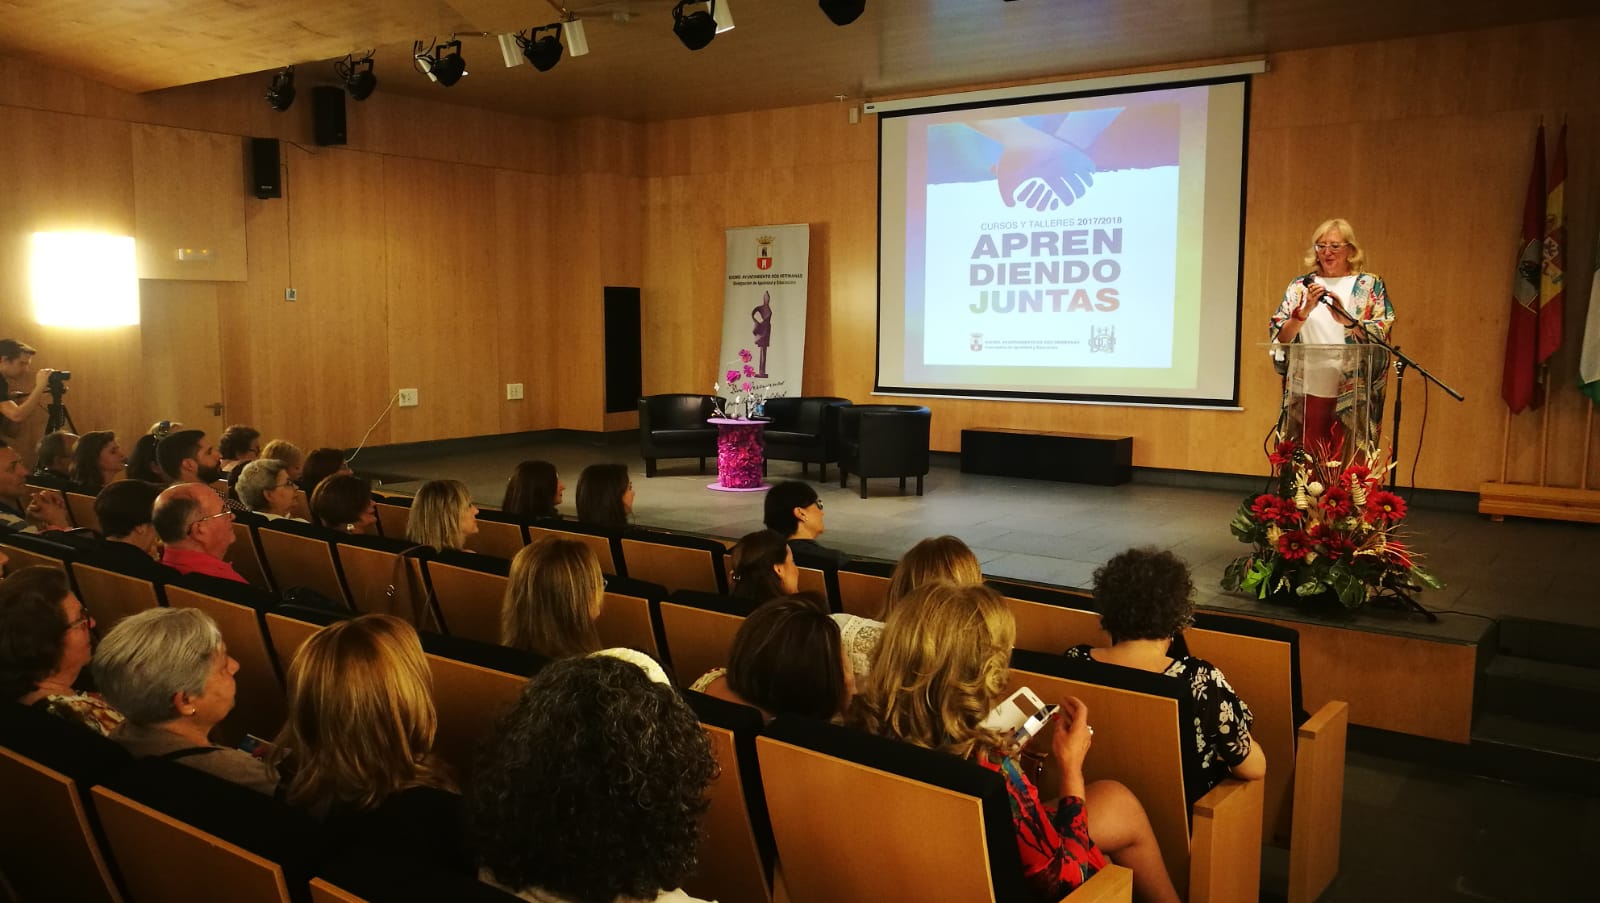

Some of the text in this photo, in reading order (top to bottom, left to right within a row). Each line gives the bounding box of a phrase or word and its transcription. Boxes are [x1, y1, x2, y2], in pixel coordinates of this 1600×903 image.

[981, 216, 1122, 231] CURSOS Y TALLERES 2017/2018
[971, 228, 1123, 259] APREN
[969, 259, 1121, 286] DIENDO
[969, 288, 1121, 314] JUNTAS
